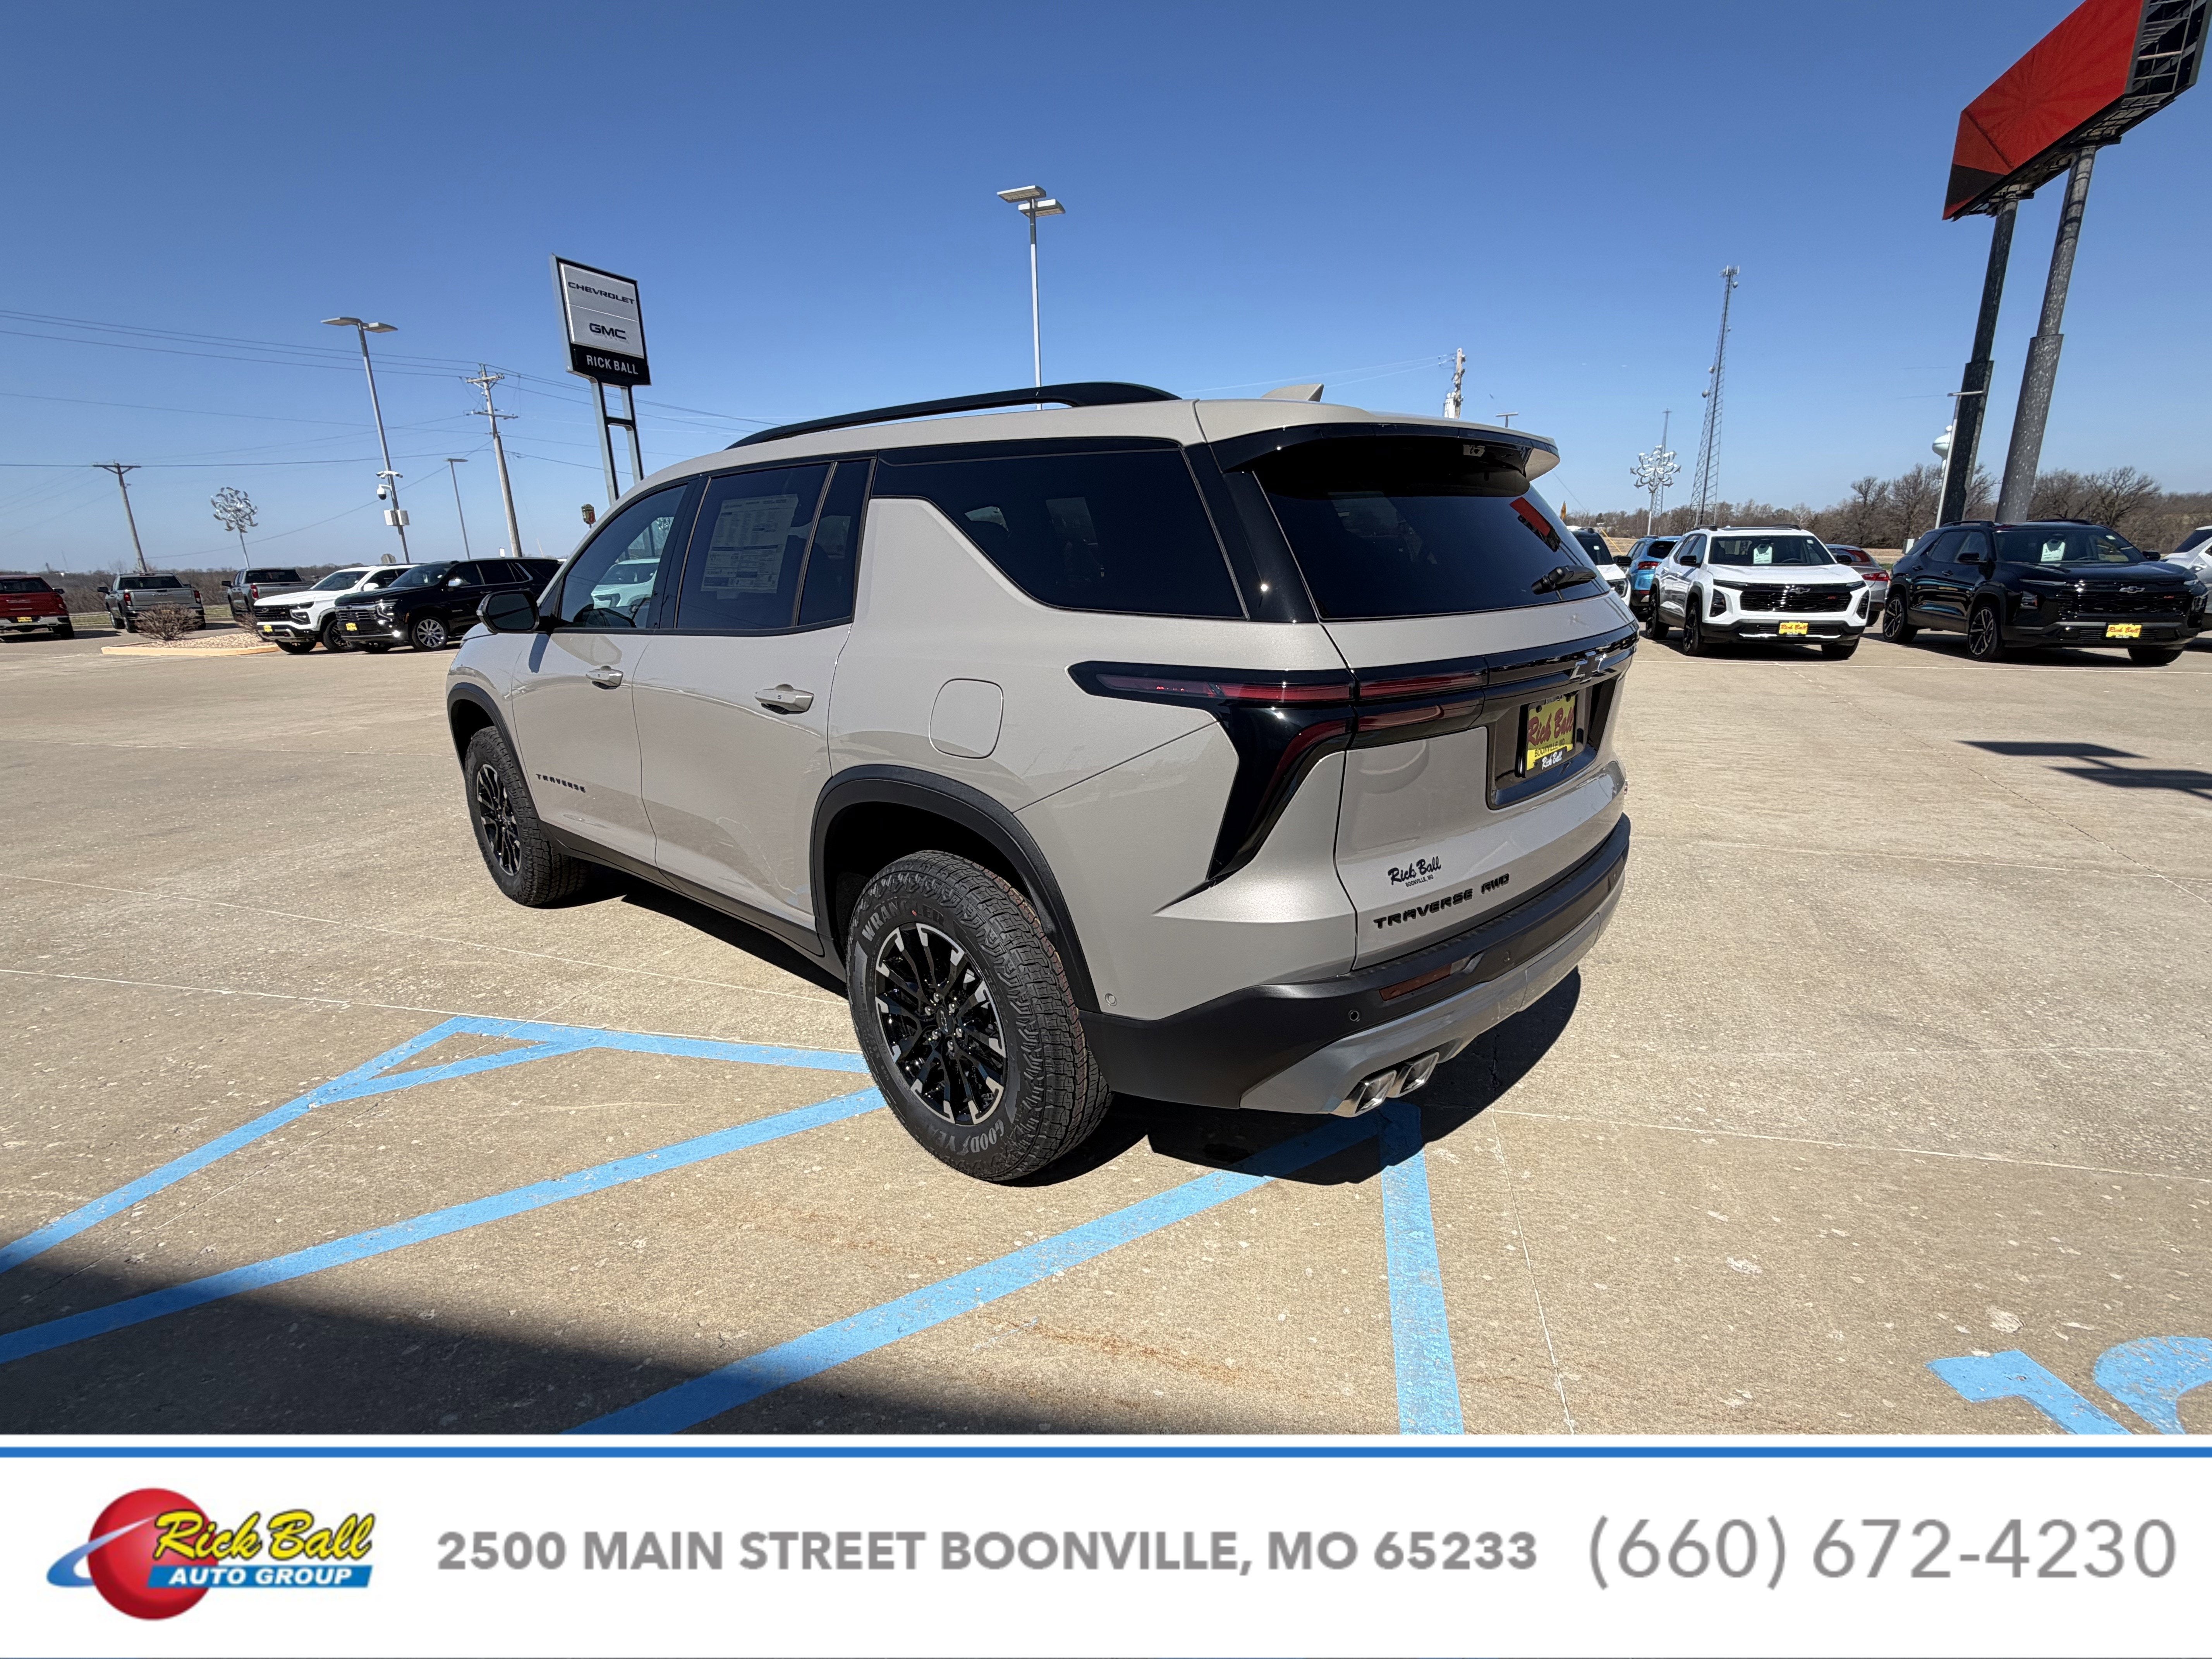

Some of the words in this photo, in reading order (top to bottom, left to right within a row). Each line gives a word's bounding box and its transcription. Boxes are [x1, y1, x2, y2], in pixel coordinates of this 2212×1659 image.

[568, 281, 635, 305] CHEVROLET
[589, 323, 627, 340] GMC
[586, 354, 612, 370] RICK
[614, 360, 639, 375] BALL
[1528, 713, 1552, 747] Rick
[1554, 706, 1575, 739] Ball
[536, 773, 586, 793] TRAVERSE
[1388, 863, 1417, 886] Rick
[1416, 856, 1441, 875] Ball
[1373, 888, 1473, 929] TRAVERSE
[1481, 873, 1510, 894] AWD
